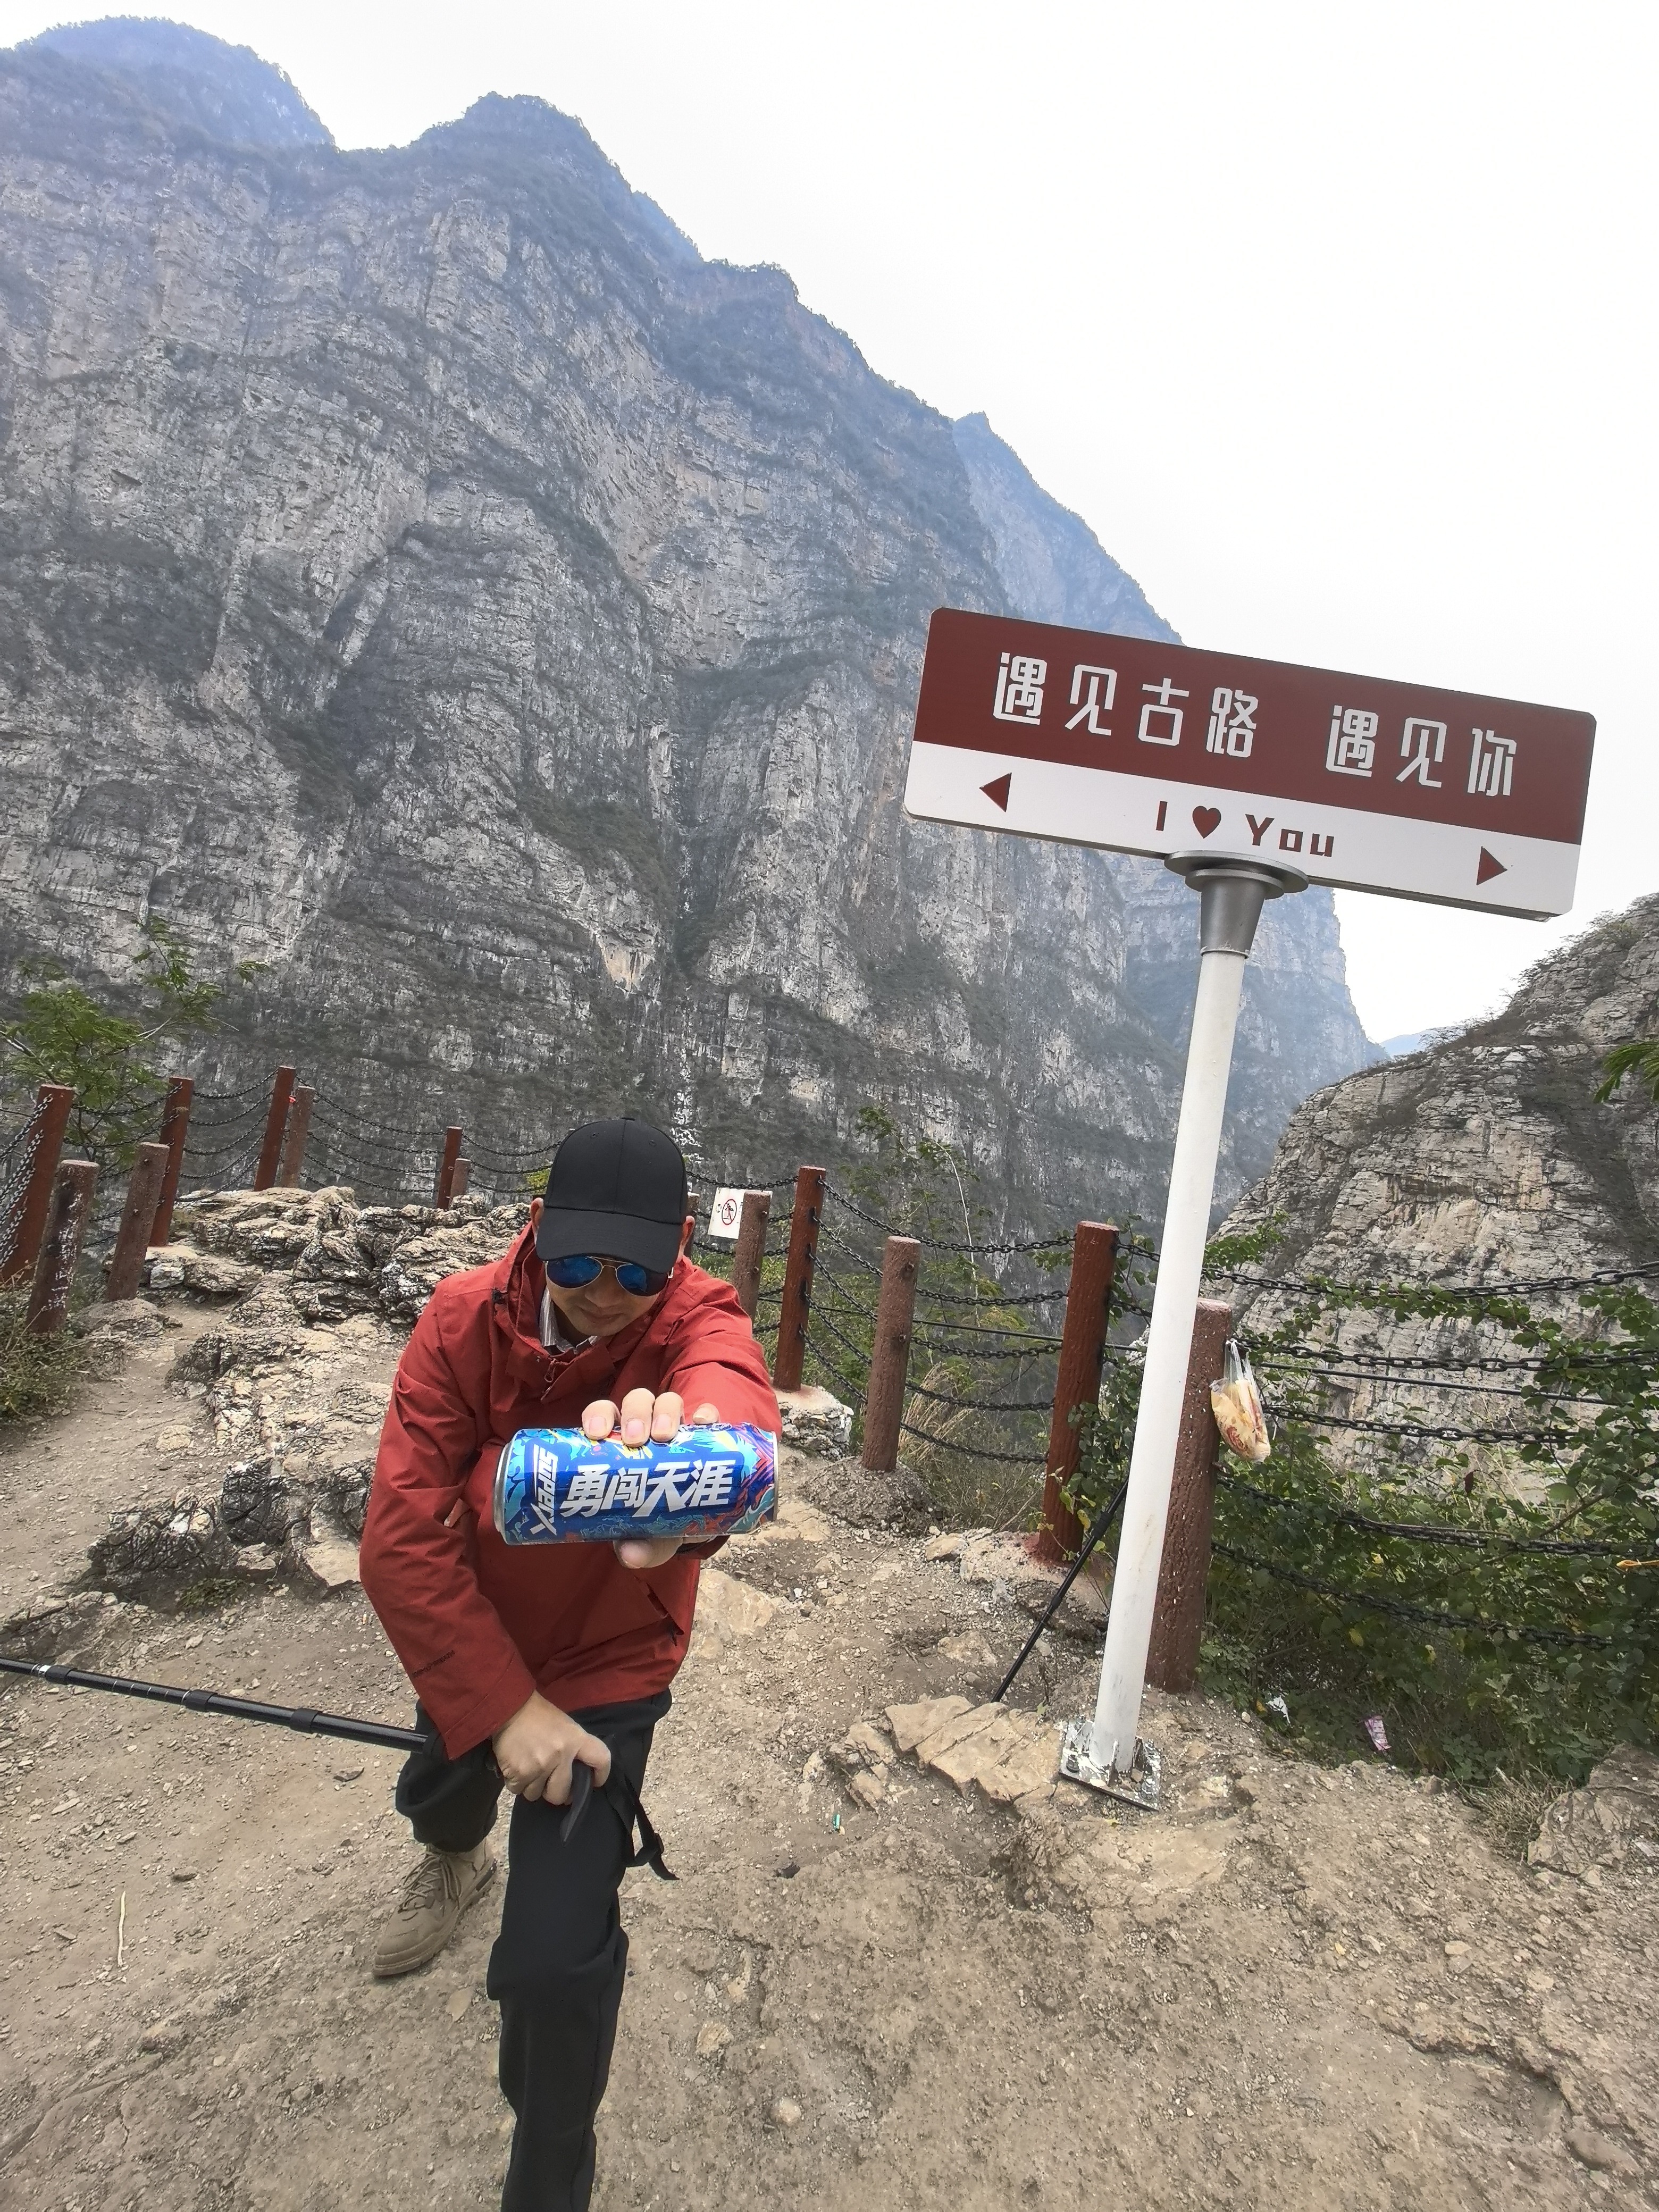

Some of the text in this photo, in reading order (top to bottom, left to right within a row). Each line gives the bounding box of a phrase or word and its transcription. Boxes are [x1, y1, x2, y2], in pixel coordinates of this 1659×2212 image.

[992, 651, 1517, 797] 遇见古路 遇见你
[1156, 801, 1334, 858] I You
[560, 1459, 736, 1518] 勇闯天涯
